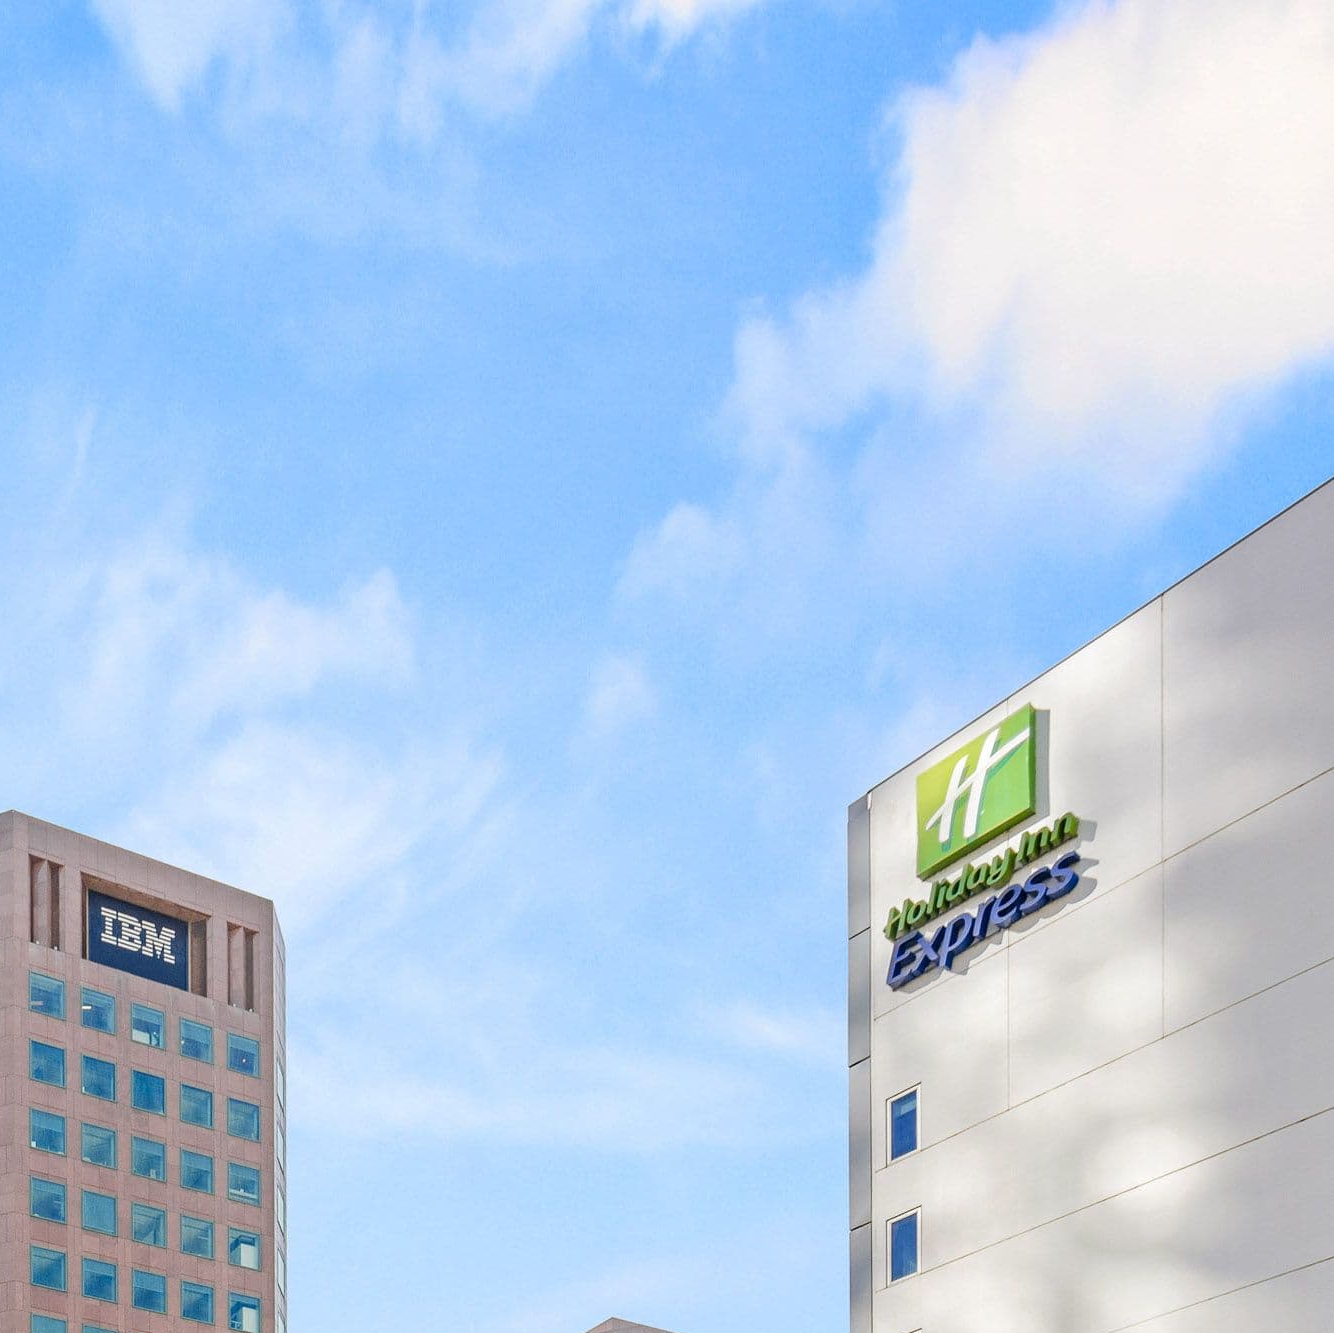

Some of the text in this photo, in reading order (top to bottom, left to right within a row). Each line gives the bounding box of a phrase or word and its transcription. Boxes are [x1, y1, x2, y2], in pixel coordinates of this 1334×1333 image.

[100, 906, 176, 965] IBM
[883, 811, 1081, 941] Holiday Inn
[886, 850, 1082, 991] Express
